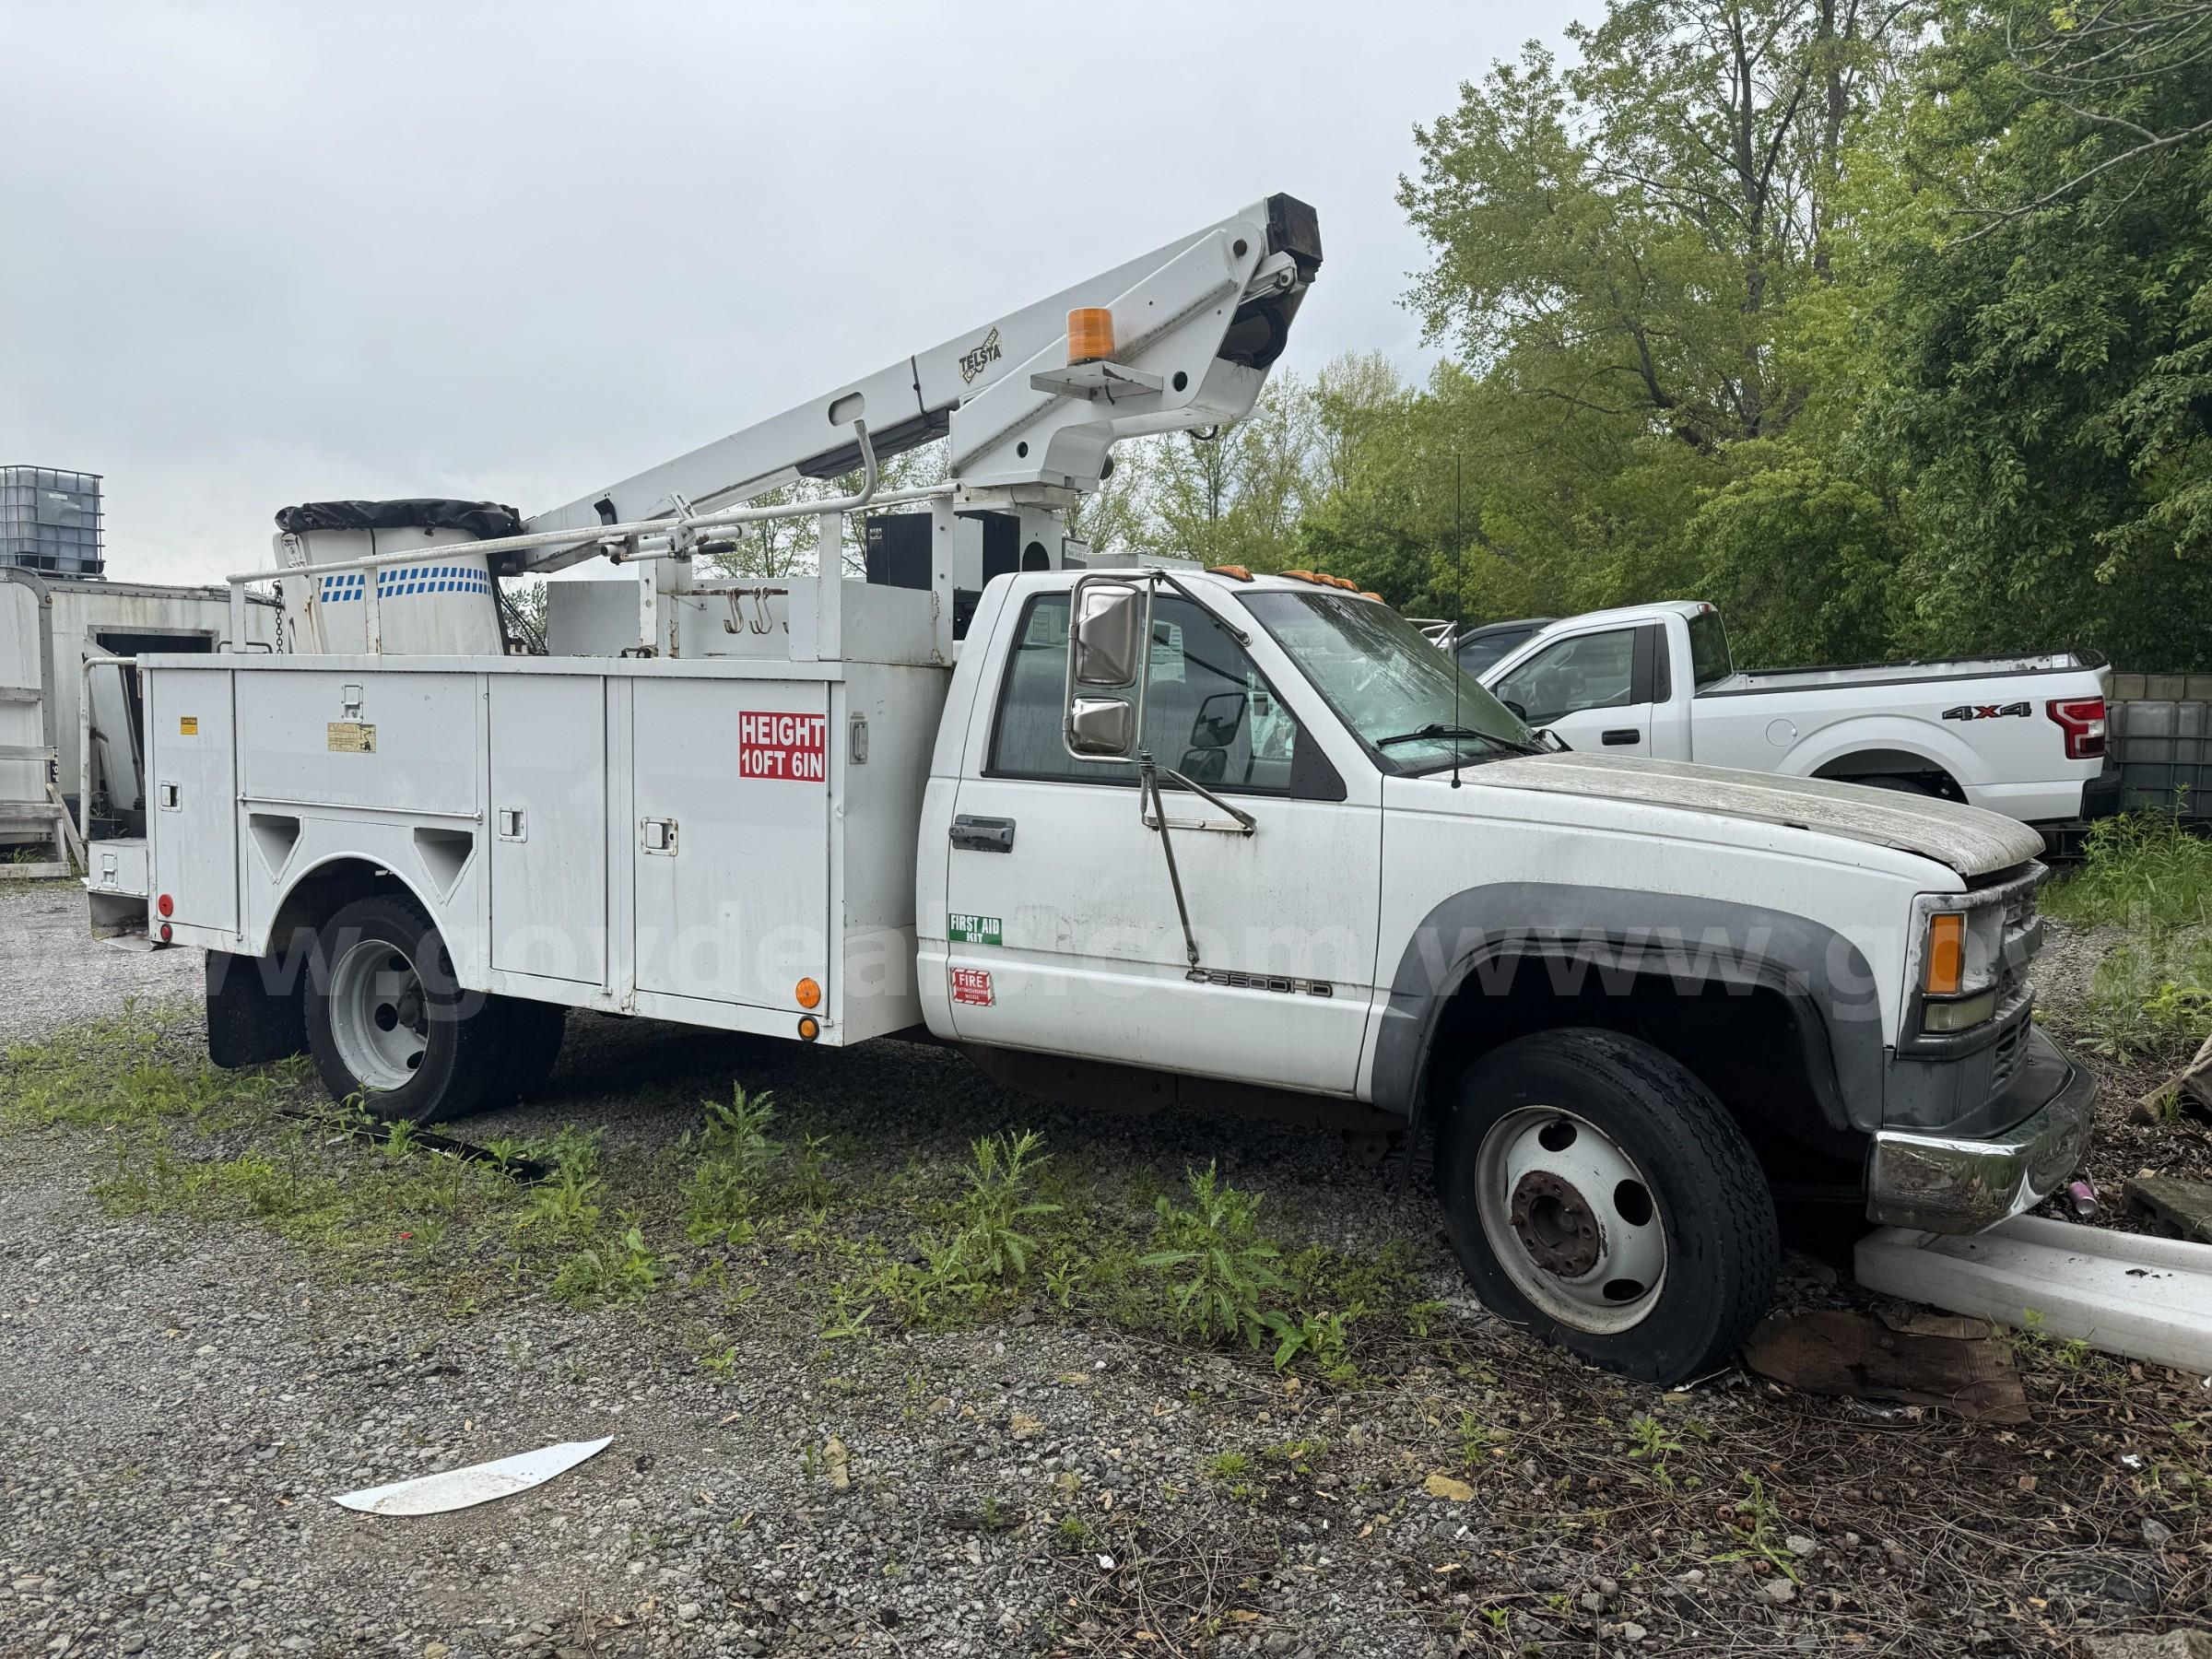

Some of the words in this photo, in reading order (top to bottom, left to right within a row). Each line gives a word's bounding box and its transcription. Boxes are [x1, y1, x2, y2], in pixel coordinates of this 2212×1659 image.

[959, 344, 1002, 371] TELSTA
[741, 715, 824, 747] HEIGHT
[741, 748, 786, 775] 10FT
[792, 751, 823, 779] 6IN
[950, 914, 978, 933] FIRST
[982, 918, 1000, 935] AID
[966, 932, 983, 943] KIT
[959, 973, 983, 988] FIRE
[1209, 972, 1334, 997] 3500HD
